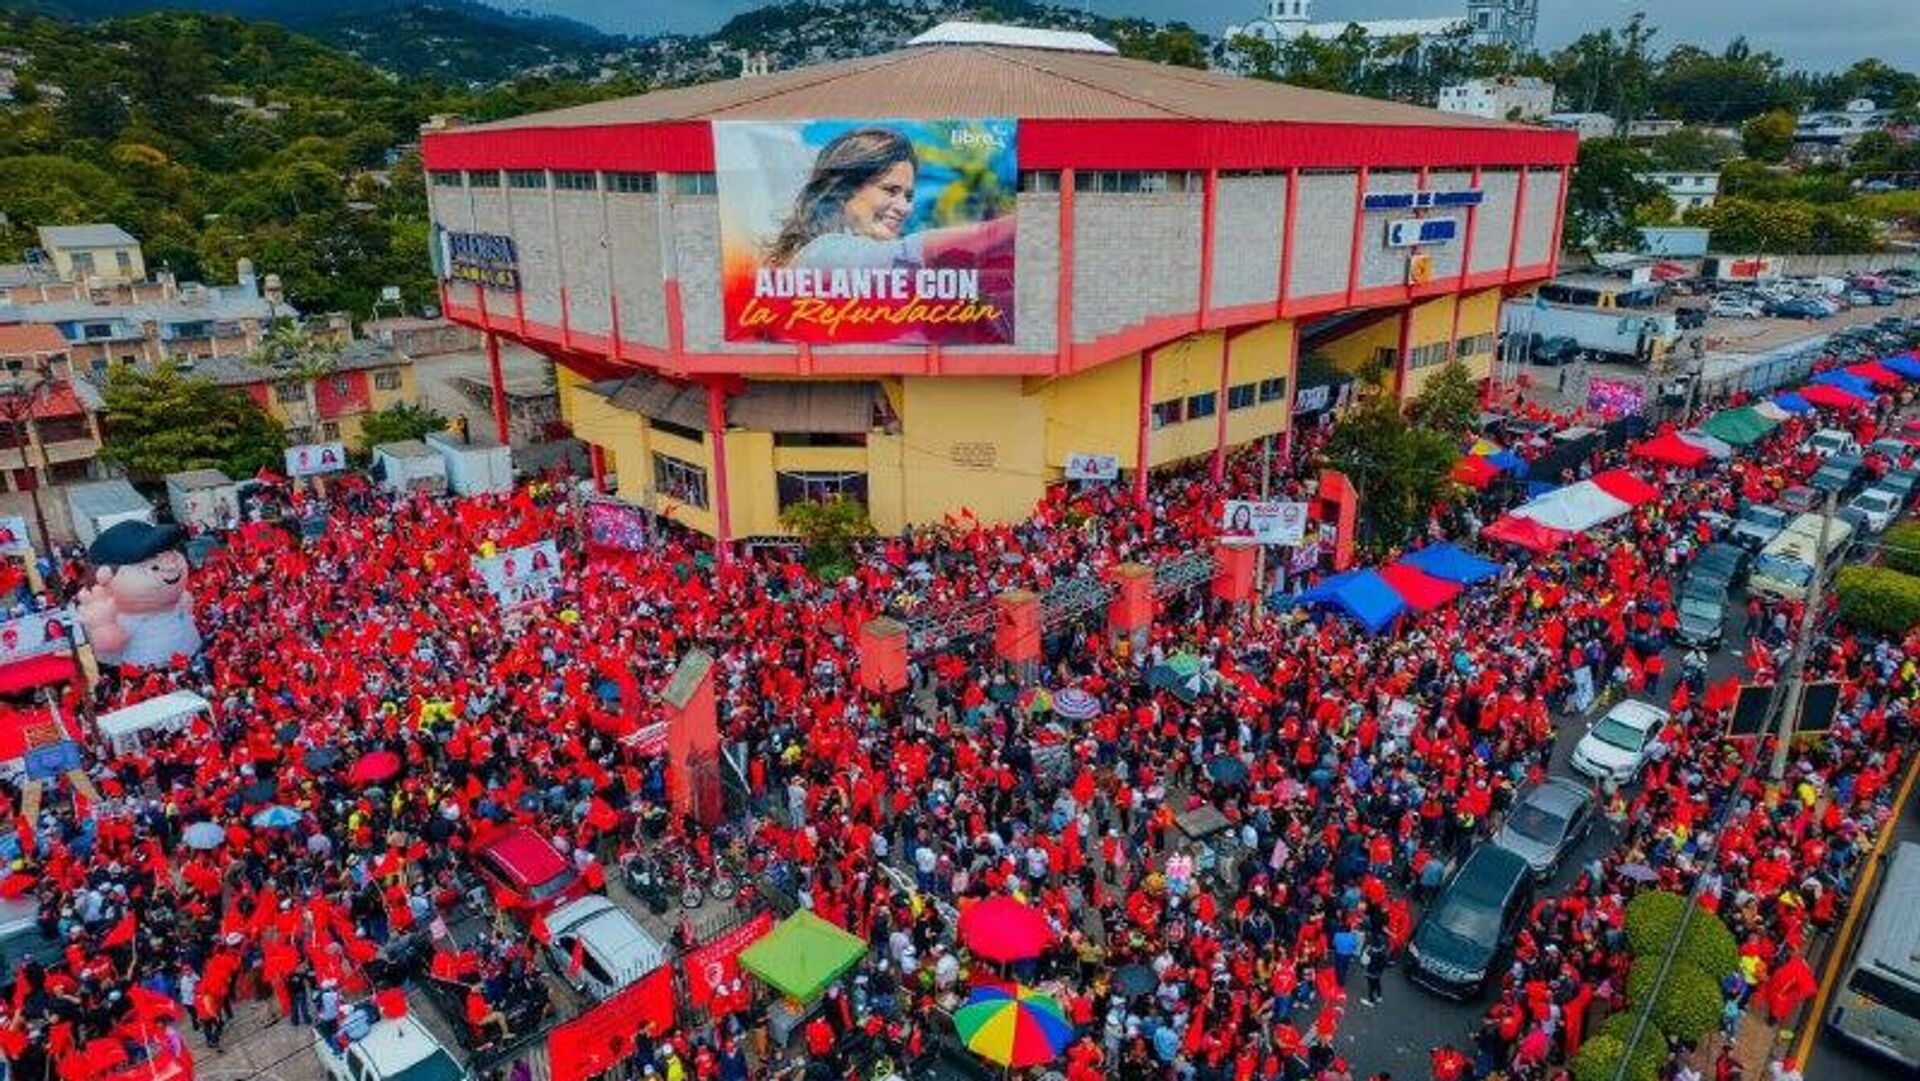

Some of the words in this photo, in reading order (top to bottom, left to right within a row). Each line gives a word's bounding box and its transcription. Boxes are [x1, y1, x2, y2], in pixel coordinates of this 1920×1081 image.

[755, 269, 907, 299] ADELANTE
[916, 269, 979, 300] CON
[739, 299, 776, 326] la
[786, 297, 1001, 336] Refundación
